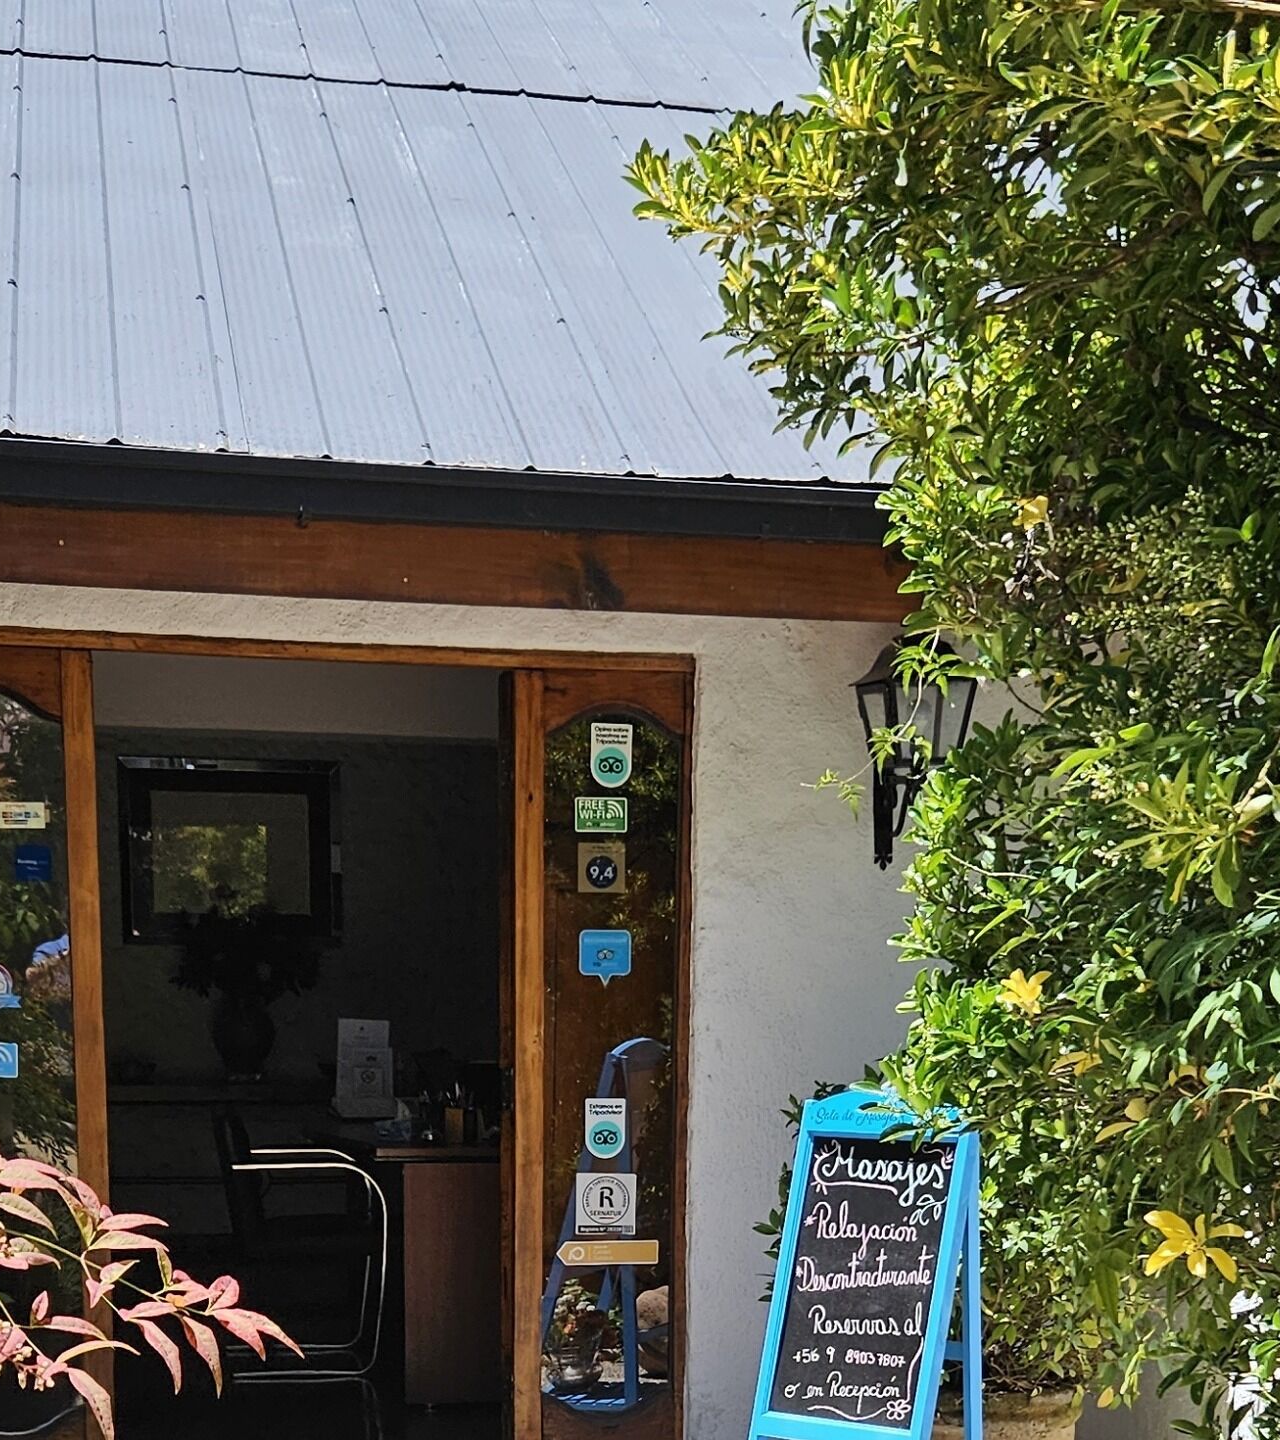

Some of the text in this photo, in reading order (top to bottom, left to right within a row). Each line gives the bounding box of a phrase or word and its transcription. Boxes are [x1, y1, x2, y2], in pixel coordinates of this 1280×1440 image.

[578, 799, 605, 810] FREE
[578, 809, 605, 819] WI-FI
[589, 865, 614, 881] 9,4
[821, 1142, 944, 1207] Masajes
[812, 1200, 918, 1260] Relajación
[797, 1244, 934, 1292] Descontracturante
[808, 1301, 923, 1336] Reservas al
[793, 1347, 820, 1364] +56
[826, 1345, 836, 1363] 9
[802, 1385, 824, 1399] en
[826, 1370, 900, 1414] Recepción
